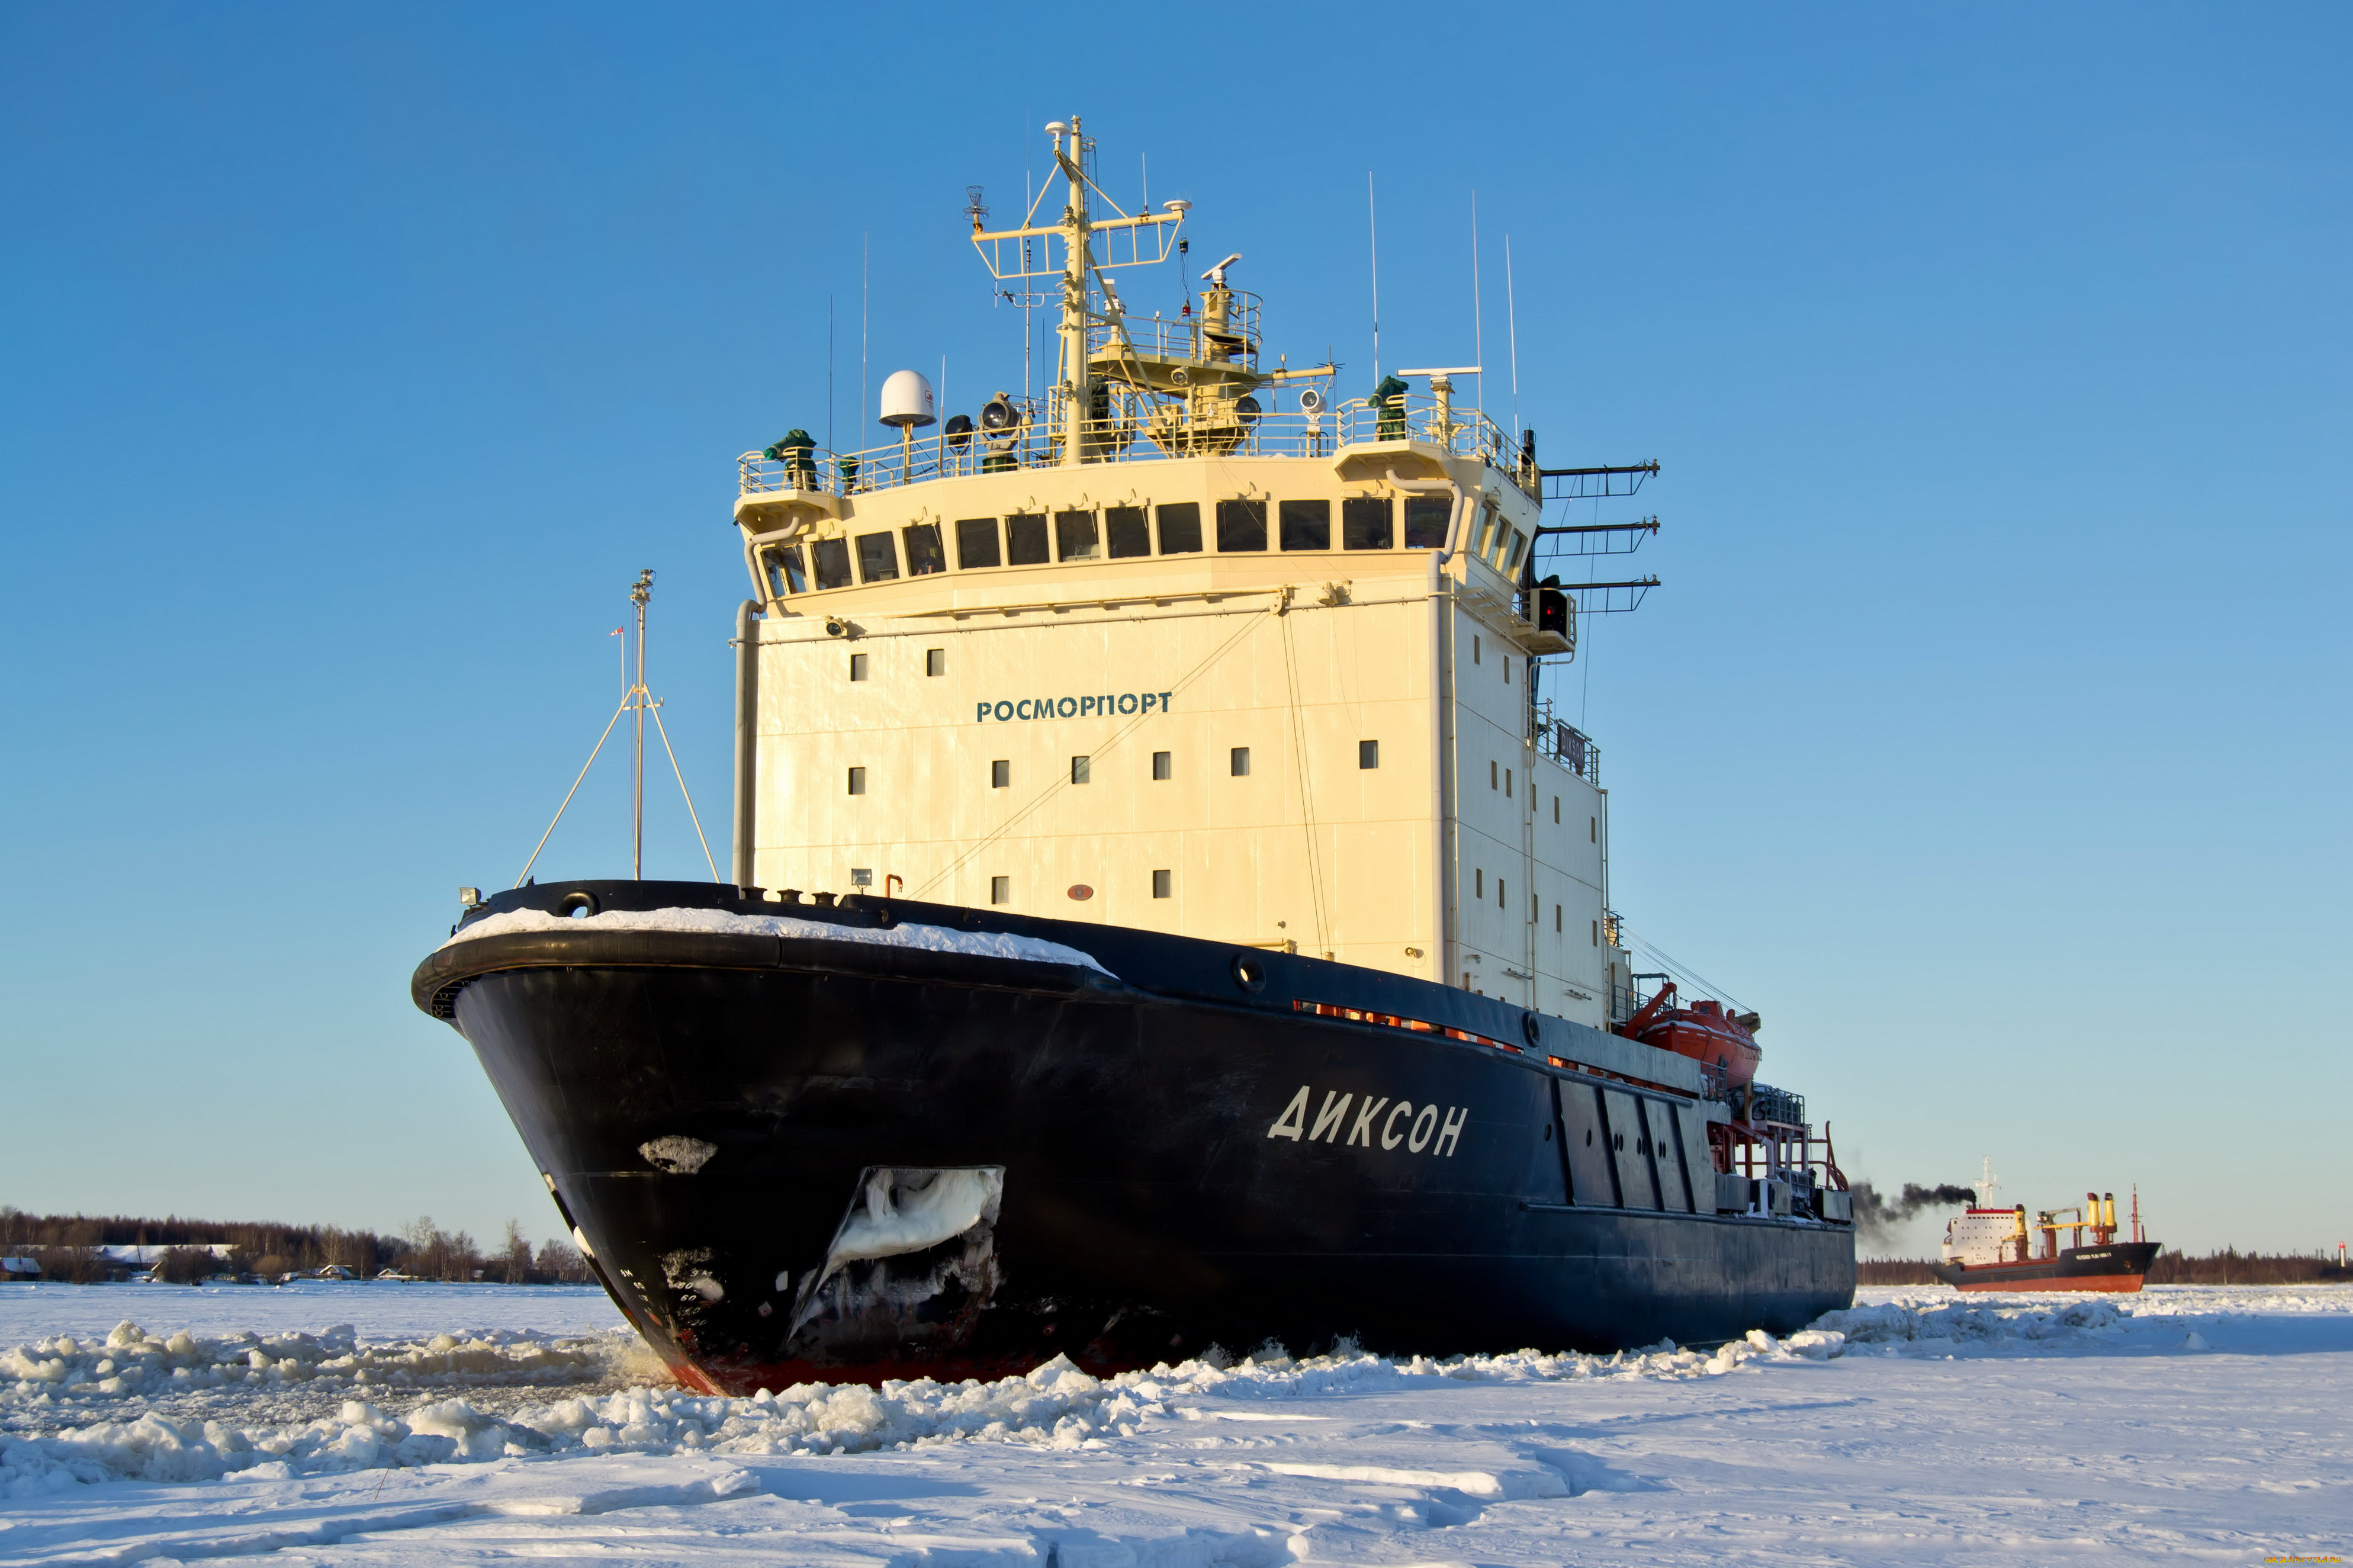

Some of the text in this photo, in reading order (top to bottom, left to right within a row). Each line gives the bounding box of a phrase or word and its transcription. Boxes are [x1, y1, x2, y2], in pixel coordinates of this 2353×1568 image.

[977, 692, 1172, 722] РОСМОРПОРТ
[1562, 732, 1584, 761] DIKSON
[1266, 1085, 1468, 1157] ДИКСОН
